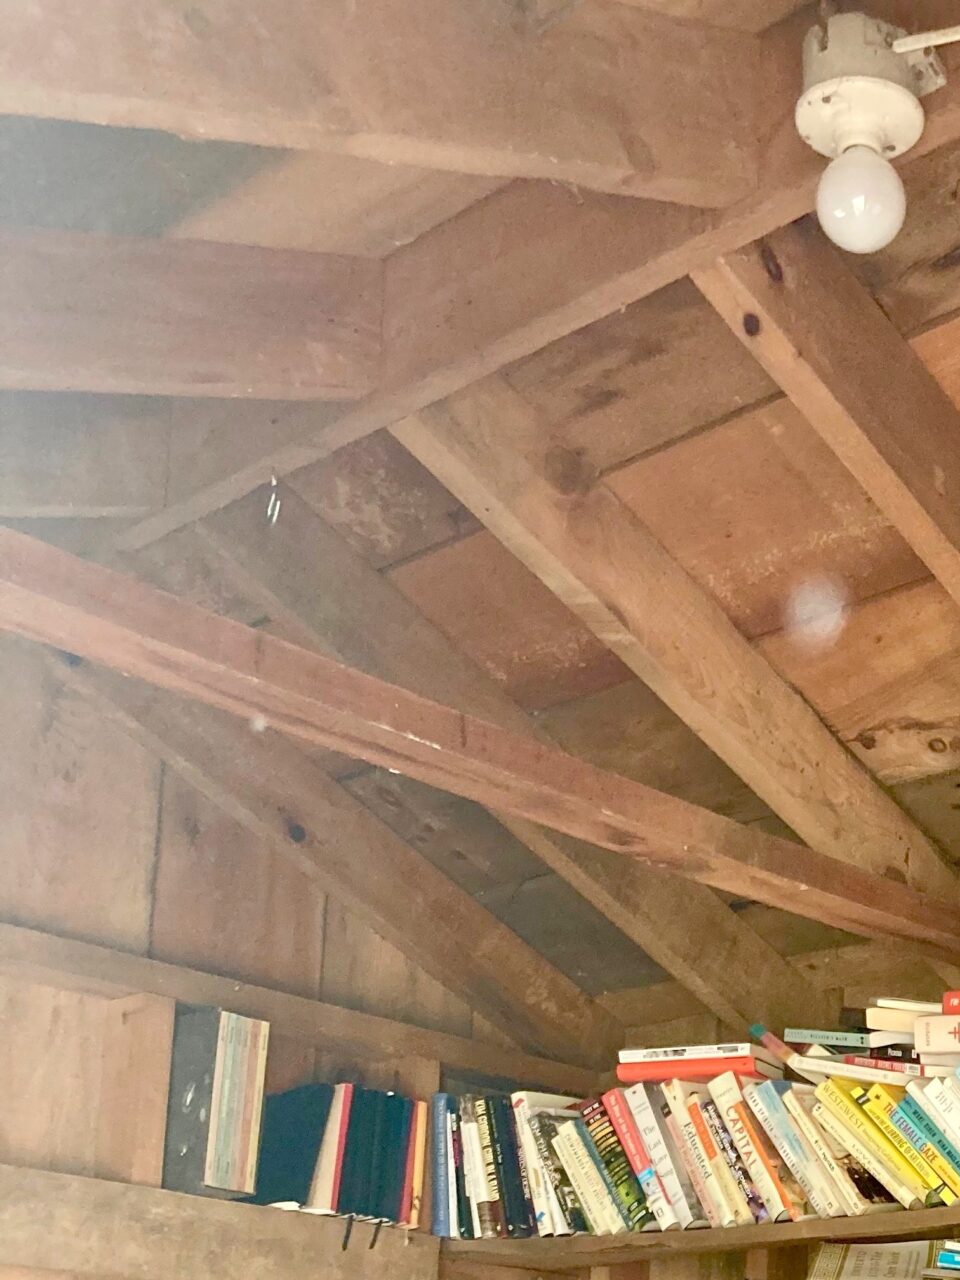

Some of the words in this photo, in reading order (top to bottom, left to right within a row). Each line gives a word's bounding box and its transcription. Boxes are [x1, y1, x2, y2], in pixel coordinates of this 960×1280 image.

[681, 1121, 713, 1181] Educated
[725, 1105, 756, 1169] CAPITAL
[882, 1100, 896, 1120] THE
[893, 1113, 928, 1153] FEMALE
[919, 1141, 938, 1165] GAZE
